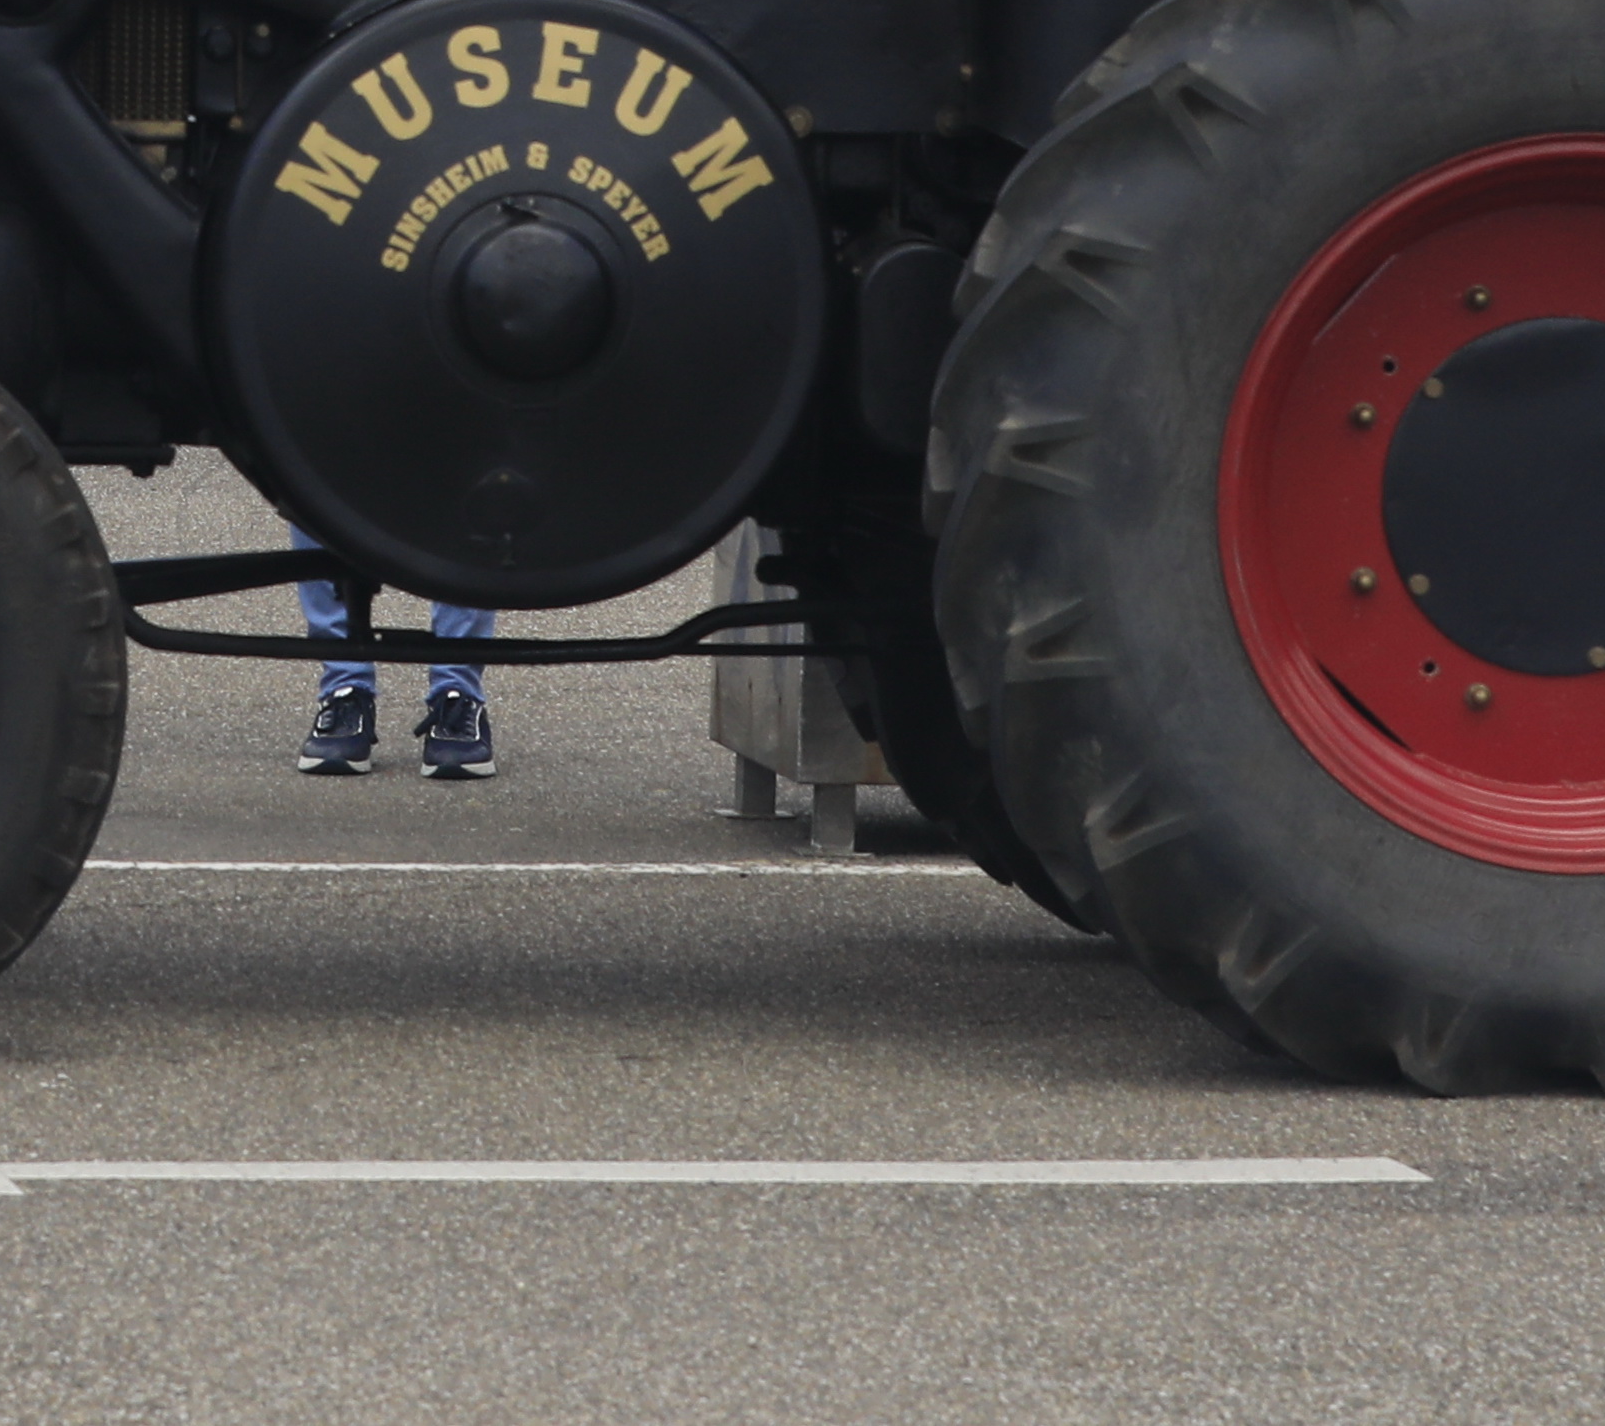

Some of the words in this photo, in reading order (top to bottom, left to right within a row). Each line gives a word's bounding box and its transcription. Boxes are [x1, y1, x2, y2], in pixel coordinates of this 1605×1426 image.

[275, 22, 773, 227] MUSEUM
[381, 144, 509, 274] SINSHEIM
[526, 141, 550, 171] &
[567, 155, 673, 265] SPEYER
